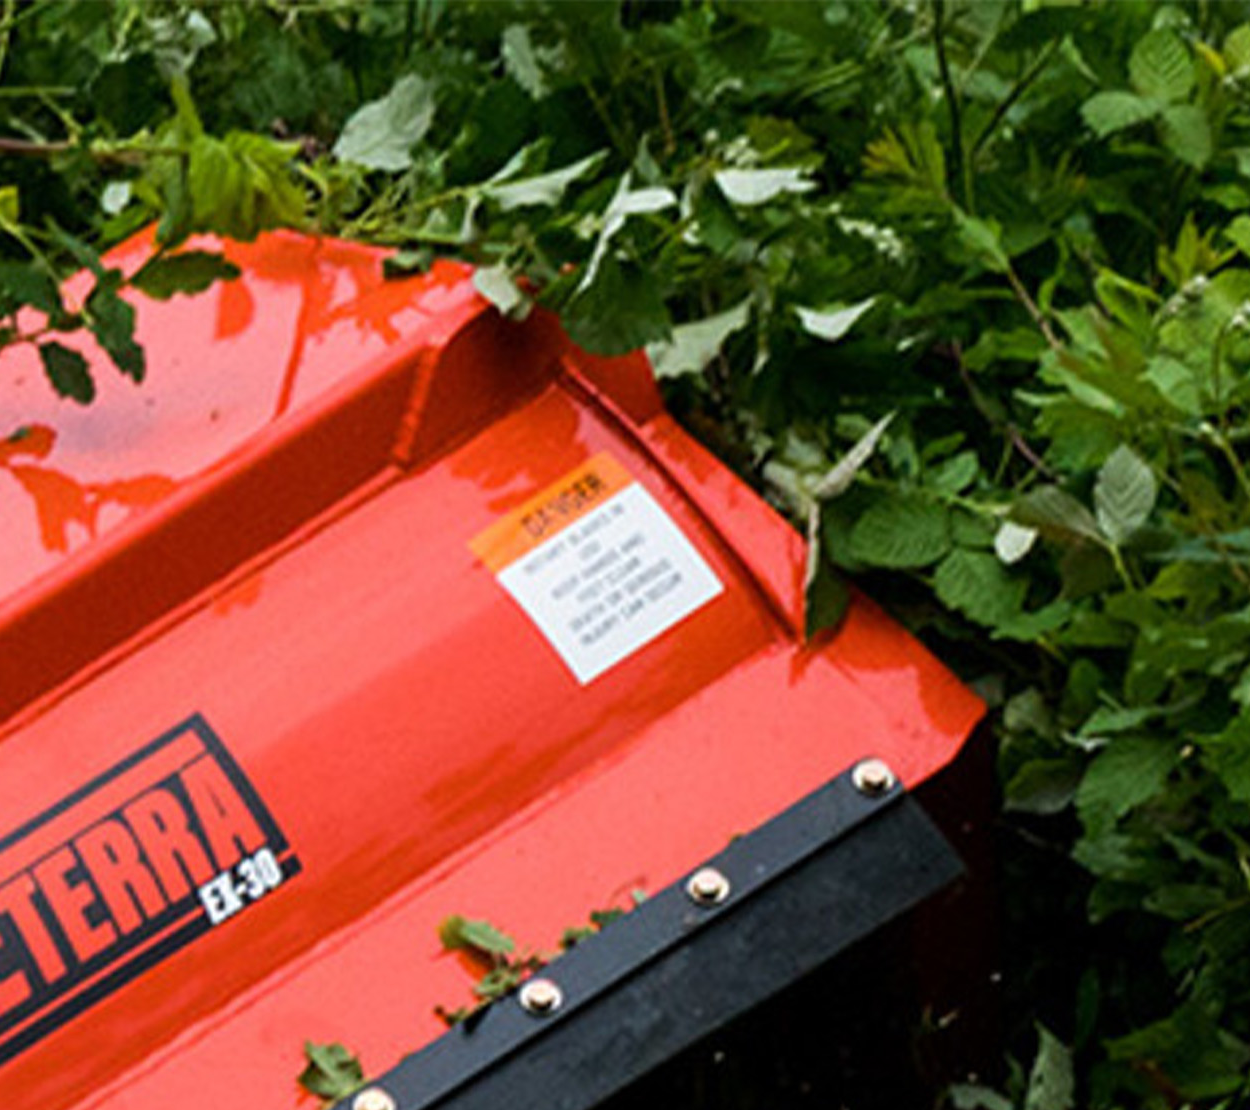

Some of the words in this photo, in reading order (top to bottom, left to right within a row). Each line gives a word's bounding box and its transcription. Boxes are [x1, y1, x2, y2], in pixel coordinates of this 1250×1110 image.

[522, 473, 604, 535] DANGER
[620, 598, 645, 617] CAN
[198, 847, 282, 925] EX-30
